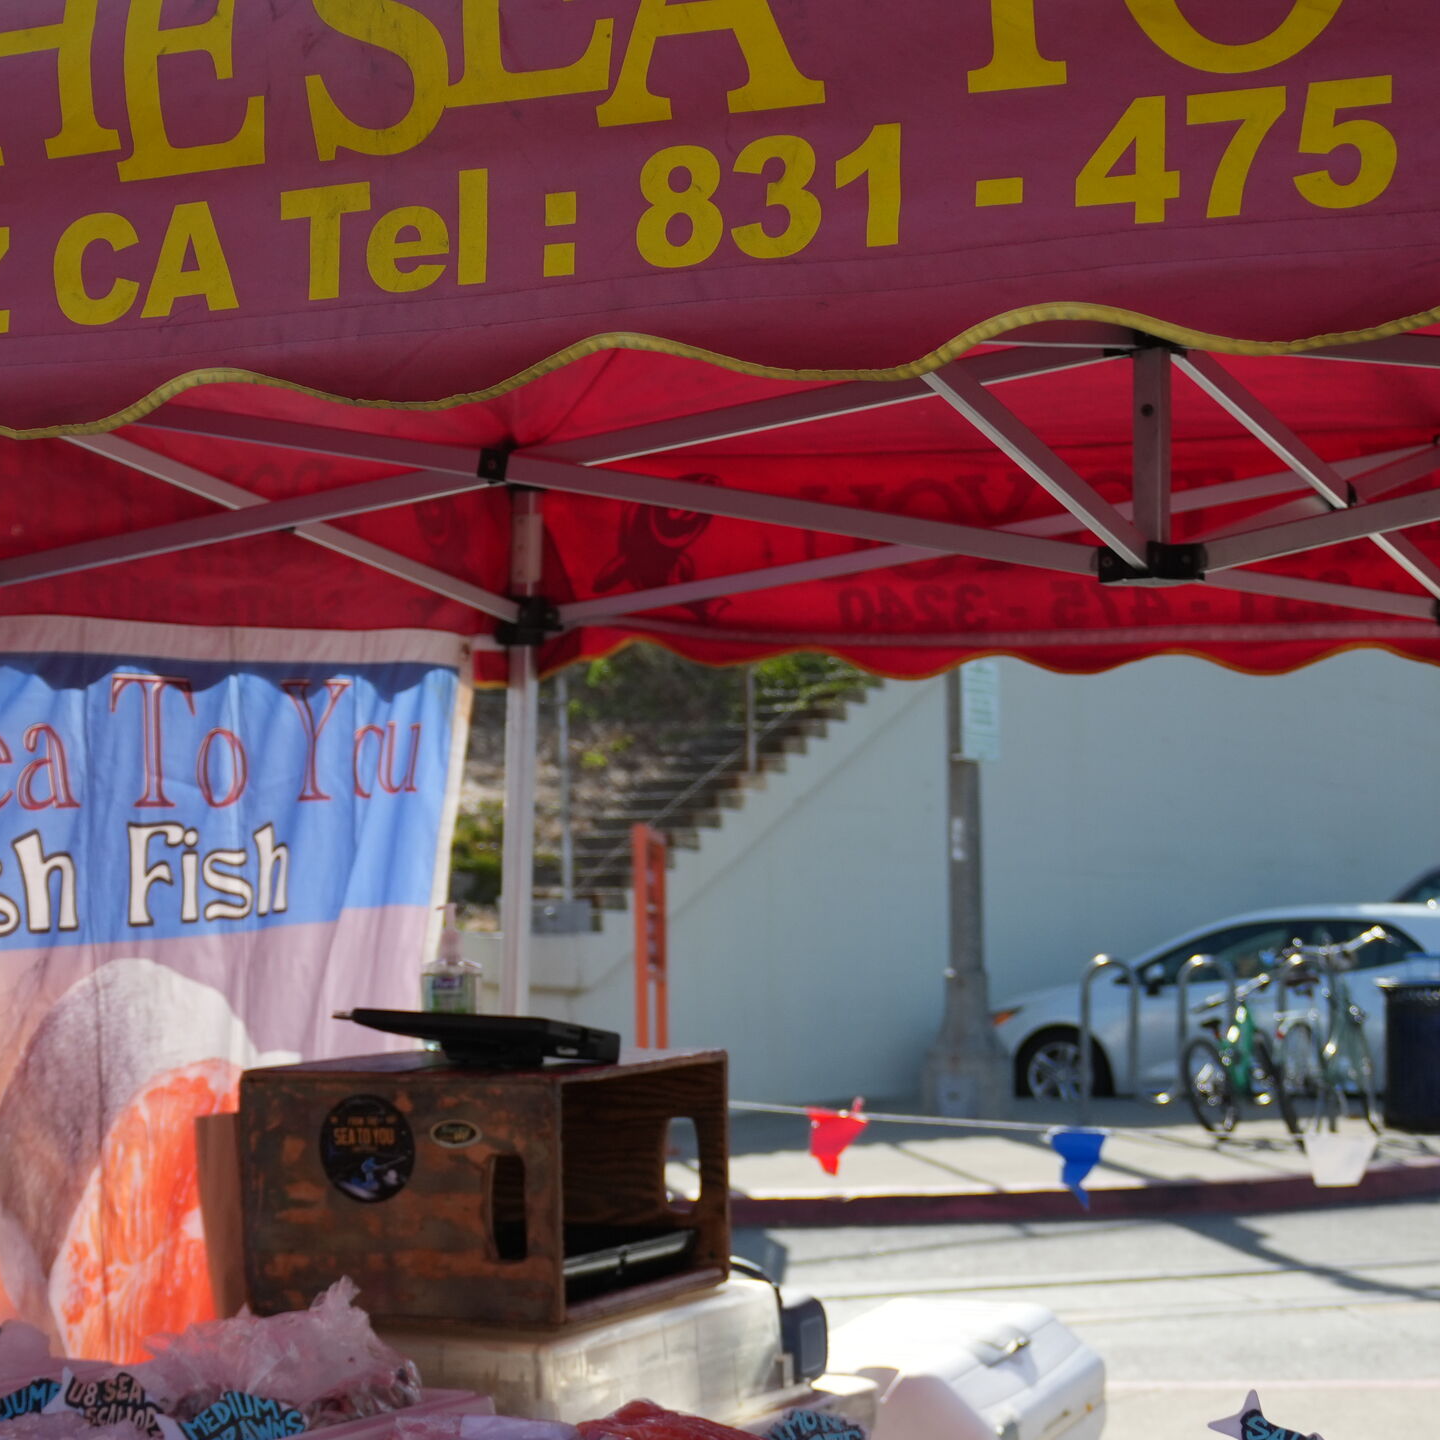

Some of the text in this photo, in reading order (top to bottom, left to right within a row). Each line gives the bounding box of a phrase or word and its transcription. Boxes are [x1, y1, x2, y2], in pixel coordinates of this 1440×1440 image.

[52, 200, 241, 328] CA
[280, 168, 490, 302] Tel
[634, 121, 903, 271] 831
[1073, 74, 1398, 225] 475
[109, 671, 249, 809] To
[280, 678, 423, 803] You
[126, 820, 291, 928] Fish
[333, 1127, 356, 1146] SEA
[372, 1127, 396, 1146] YOU
[103, 1377, 142, 1399] SEA
